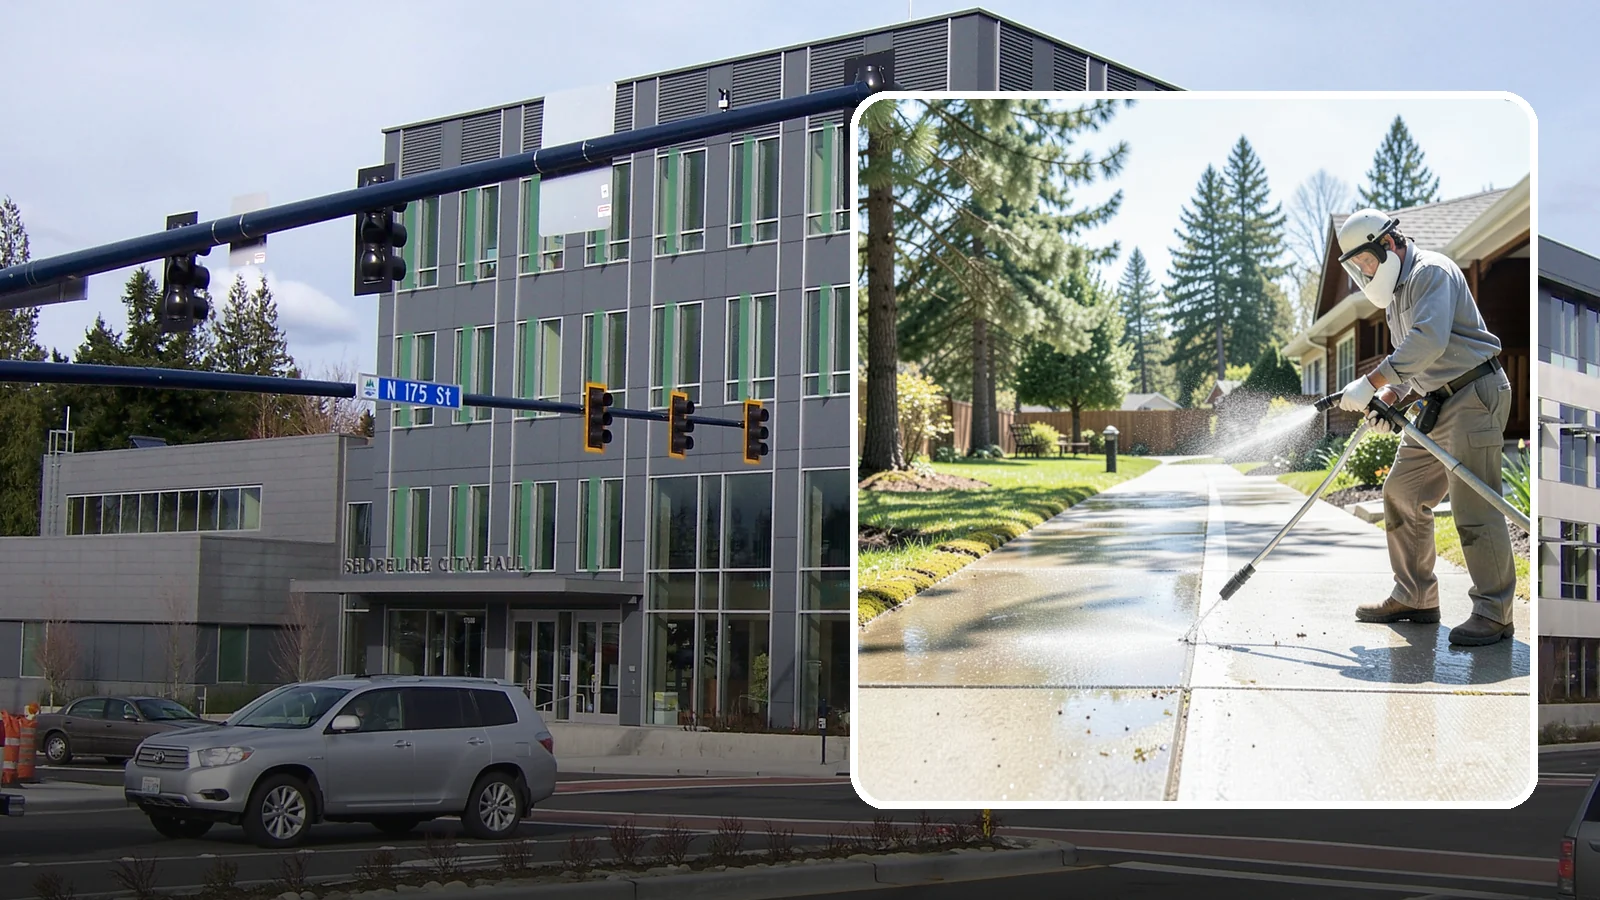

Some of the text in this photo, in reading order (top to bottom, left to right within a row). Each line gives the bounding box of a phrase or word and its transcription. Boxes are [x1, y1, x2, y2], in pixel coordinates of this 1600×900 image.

[387, 381, 452, 406] N 175 St
[344, 555, 526, 574] SHORELINE CITY HALL
